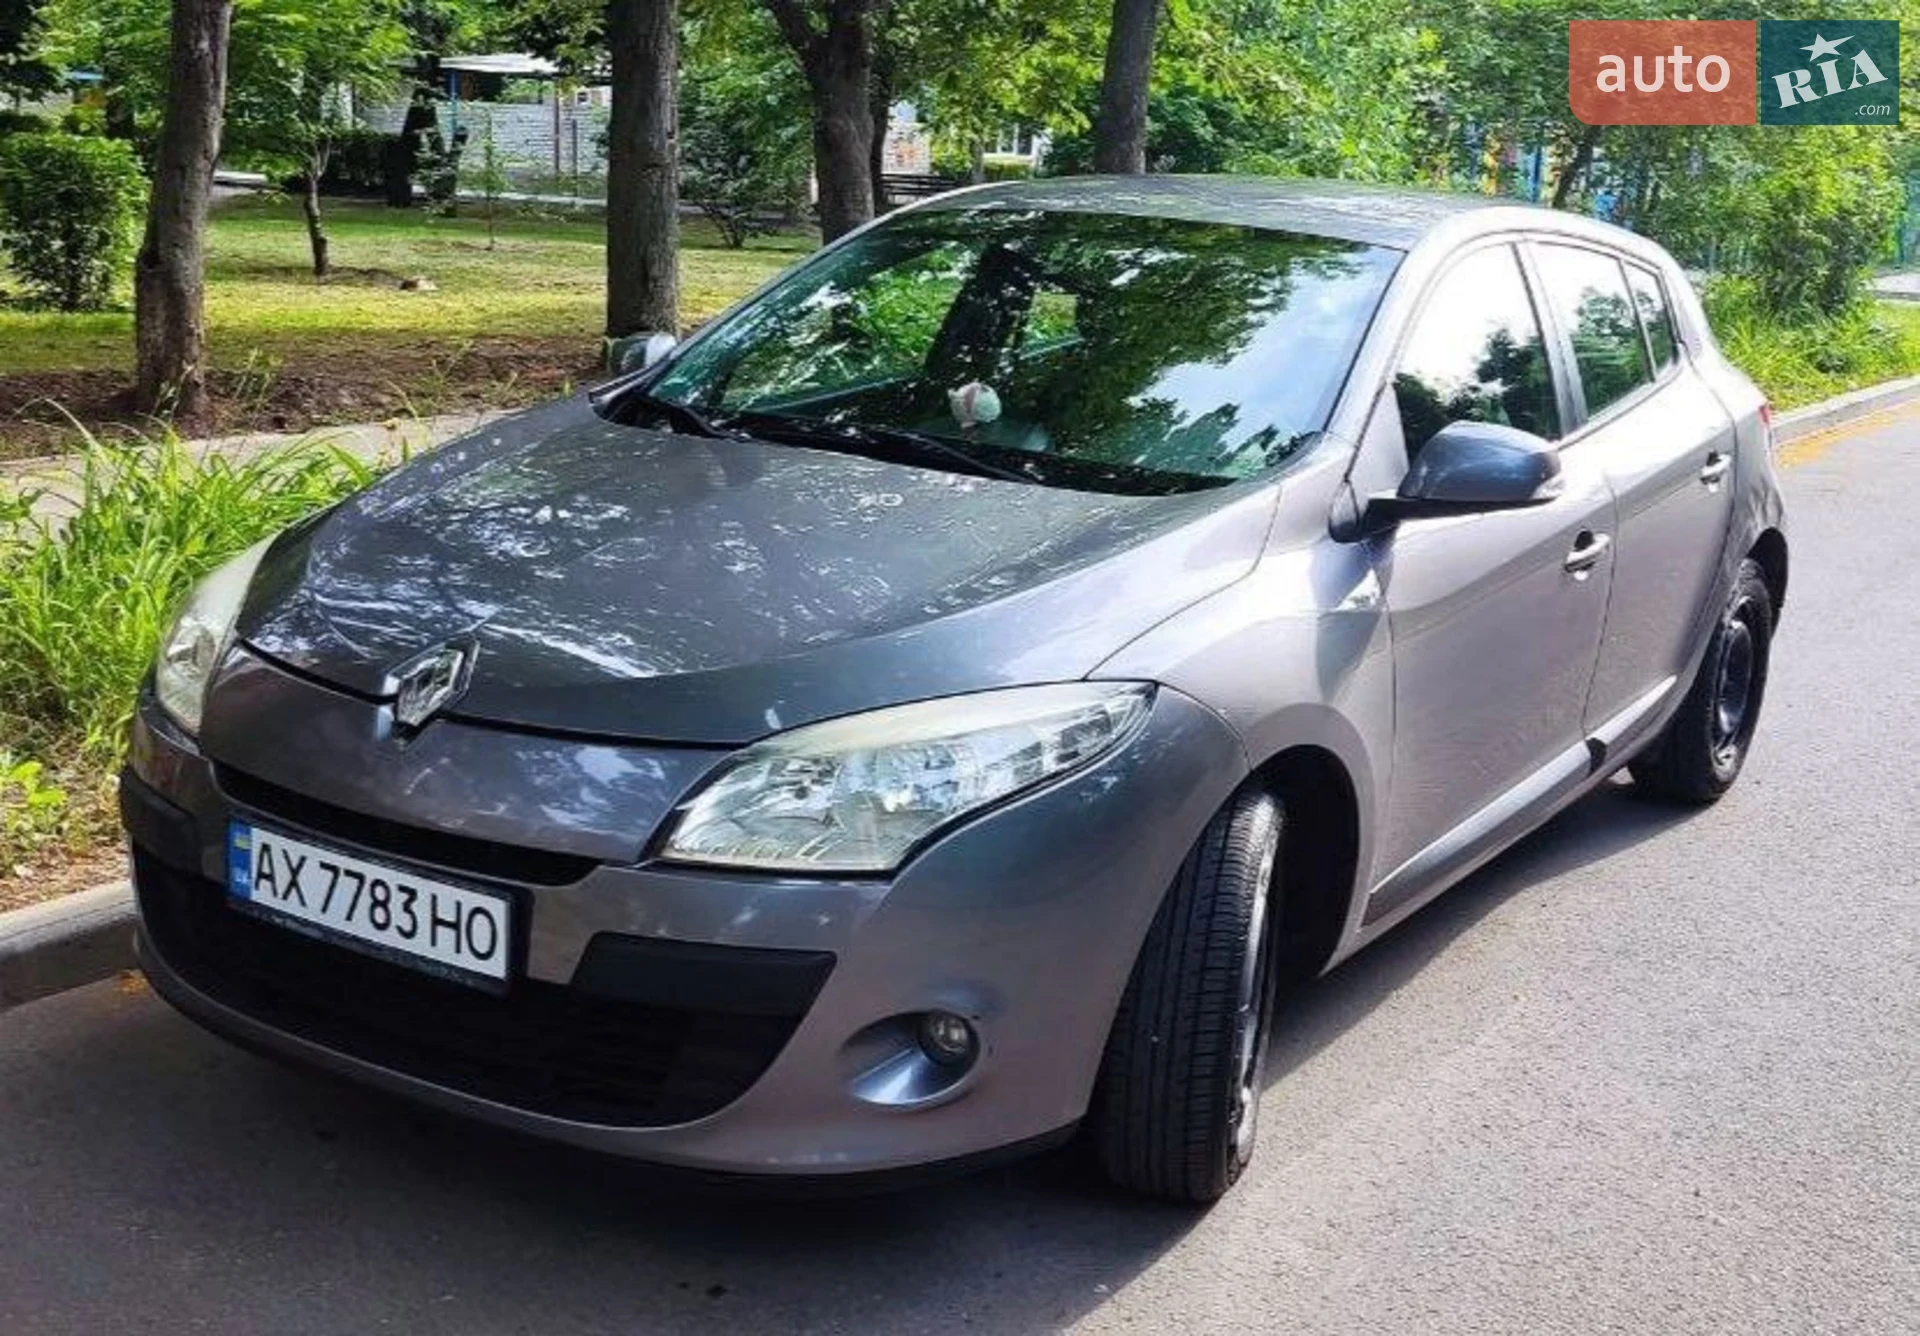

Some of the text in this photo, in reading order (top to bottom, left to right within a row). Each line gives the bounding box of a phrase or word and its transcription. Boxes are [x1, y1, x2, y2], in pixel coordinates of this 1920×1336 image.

[254, 842, 307, 907] AX
[319, 860, 419, 940] 7783
[430, 893, 497, 960] HO
